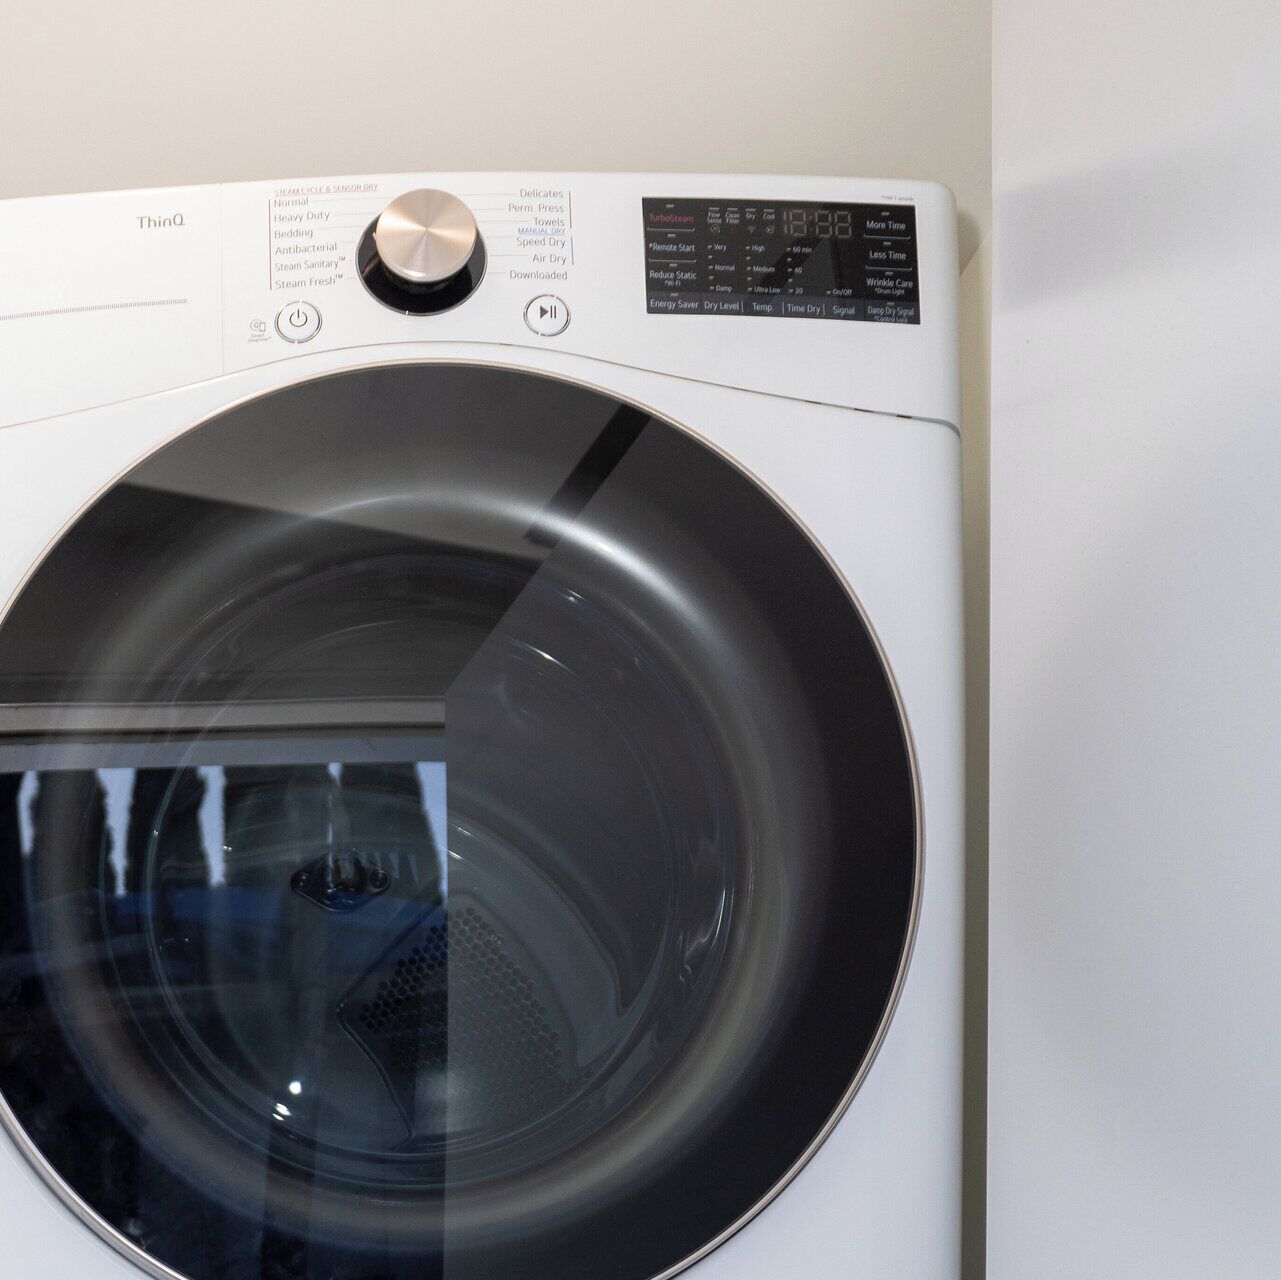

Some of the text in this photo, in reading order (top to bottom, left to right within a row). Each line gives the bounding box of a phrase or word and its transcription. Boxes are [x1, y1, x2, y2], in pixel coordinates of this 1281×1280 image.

[275, 188, 300, 197] STEAM
[333, 185, 361, 193] SENSOR
[520, 189, 563, 198] Delicates
[274, 197, 309, 207] Normal
[539, 203, 564, 212] Press
[137, 214, 185, 229] ThinQ
[274, 210, 330, 223] Heavy Duty
[534, 217, 565, 226] Towels
[650, 214, 694, 223] TurboSteam
[866, 220, 906, 230] More Time
[274, 228, 313, 239] Bedding
[518, 227, 548, 235] MANUAL
[517, 237, 565, 248] Speed Dry
[679, 243, 695, 252] Start
[275, 243, 337, 255] Antibacterial
[533, 254, 567, 266] Air Dry
[870, 251, 906, 260] Less Time
[275, 261, 301, 272] Steam
[510, 270, 568, 280] Downloaded
[650, 270, 697, 280] Reduce Static
[276, 279, 306, 290] Steam
[867, 278, 913, 288] Wrinkle Care
[650, 299, 698, 309] Energy Saver
[704, 301, 740, 311] Dry Level
[752, 302, 774, 312] Temp.
[787, 304, 821, 314] Time Dry
[833, 306, 855, 315] Signal
[868, 305, 914, 316] Damp Dry Signal
